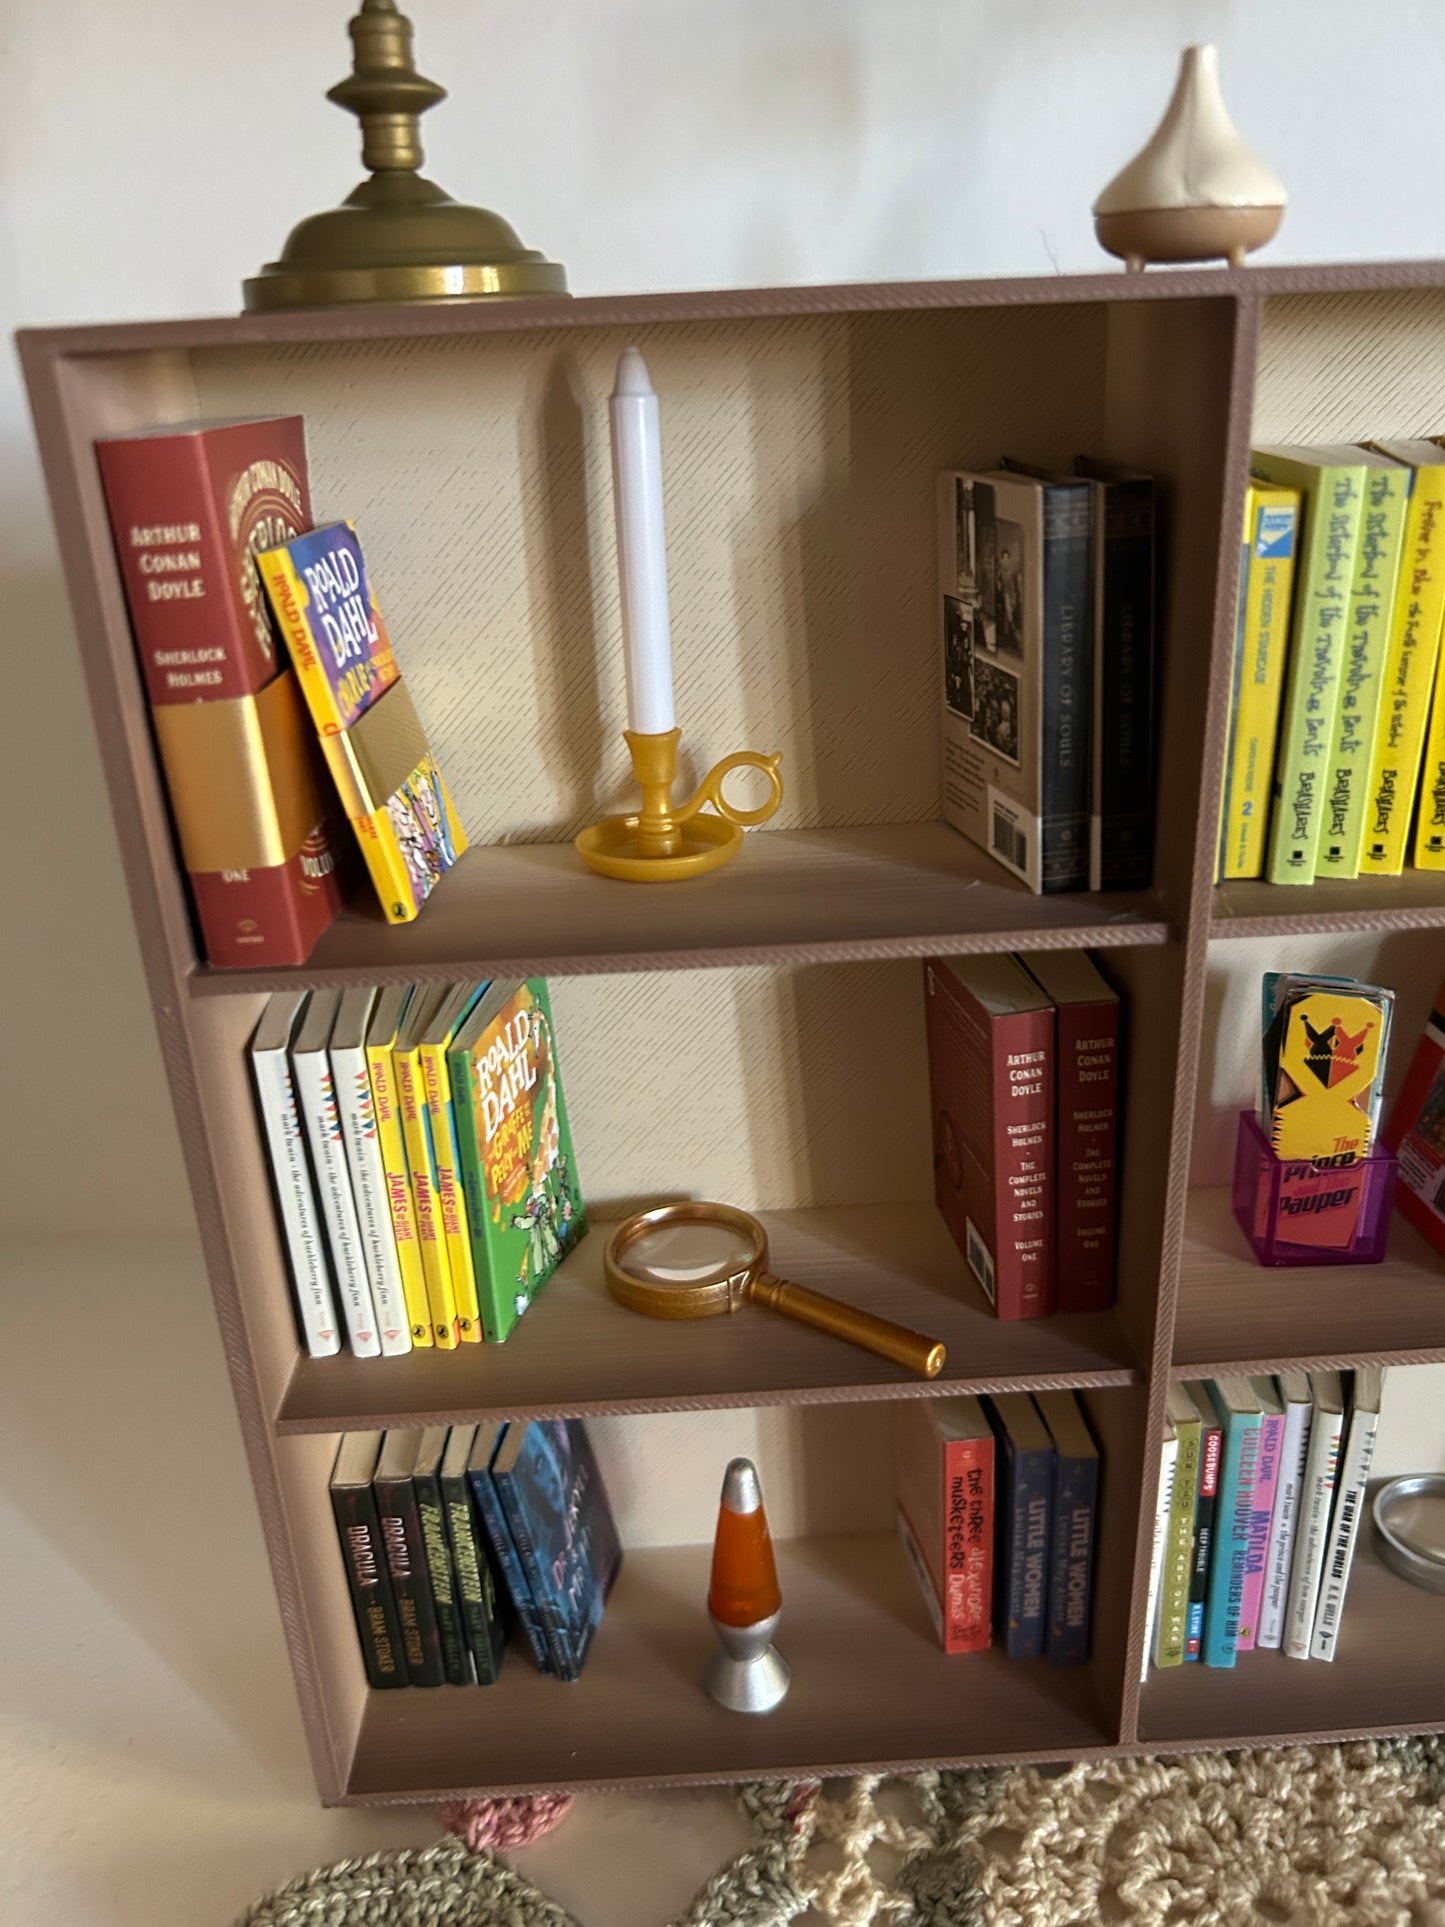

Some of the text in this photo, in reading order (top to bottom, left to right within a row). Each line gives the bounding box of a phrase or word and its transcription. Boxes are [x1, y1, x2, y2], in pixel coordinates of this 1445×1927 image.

[130, 523, 201, 546] ARTHUR
[138, 552, 201, 574] CONAN
[147, 579, 206, 601] DOYLE
[304, 548, 359, 613] ROALD
[272, 574, 317, 671] ROALD DAHL
[321, 595, 379, 668] DAHL
[153, 648, 227, 666] SHERLOCK
[166, 670, 223, 688] HOLMES
[1058, 604, 1075, 769] LIBRARY OF SOULS
[1241, 801, 1255, 817] 2
[1075, 1037, 1114, 1050] ARTHUR
[476, 1009, 530, 1099] ROALD
[1007, 1051, 1046, 1066] ARTHUR
[1077, 1054, 1111, 1066] CONAN
[1010, 1067, 1043, 1081] CONAN
[1079, 1070, 1110, 1082] DOYLE
[481, 1048, 537, 1144] DAHL
[1011, 1083, 1042, 1097] DOYLE
[1072, 1109, 1113, 1121] SHERLOCK
[1007, 1121, 1047, 1134] SHERLOCK
[1012, 1135, 1043, 1147] HOLMES
[1334, 1136, 1359, 1153] The
[1020, 1162, 1035, 1171] THE
[436, 1164, 456, 1206] JAMES
[1008, 1172, 1047, 1184] COMPLETE
[387, 1172, 407, 1212] JAMES
[413, 1171, 432, 1213] JAMES
[1014, 1186, 1042, 1197] NOVELS
[1280, 1187, 1359, 1215] Pauper
[1021, 1199, 1036, 1208] AND
[1013, 1211, 1043, 1221] STORIES
[1015, 1239, 1043, 1249] VOLUME
[1021, 1253, 1037, 1261] ONE
[1259, 1420, 1279, 1483] ROALD DAHL
[1203, 1435, 1219, 1491] GOOSEBUMPS
[1345, 1490, 1357, 1504] THE
[1342, 1505, 1355, 1522] WAR
[1178, 1517, 1188, 1546] THE
[1224, 1428, 1260, 1637] COLLEEN HOOVER REMINDERS OF HIM
[1340, 1523, 1351, 1533] OF
[381, 1517, 411, 1577] DRACULA
[1245, 1510, 1270, 1574] MATILDA
[1337, 1535, 1349, 1548] THE
[1023, 1497, 1046, 1617] LITTLE WOMEN
[1067, 1506, 1091, 1626] LITTLE WOMEN
[1332, 1549, 1347, 1579] WORLDS
[1175, 1554, 1185, 1582] ART
[347, 1525, 395, 1672] DRACULA BRAM STOKER
